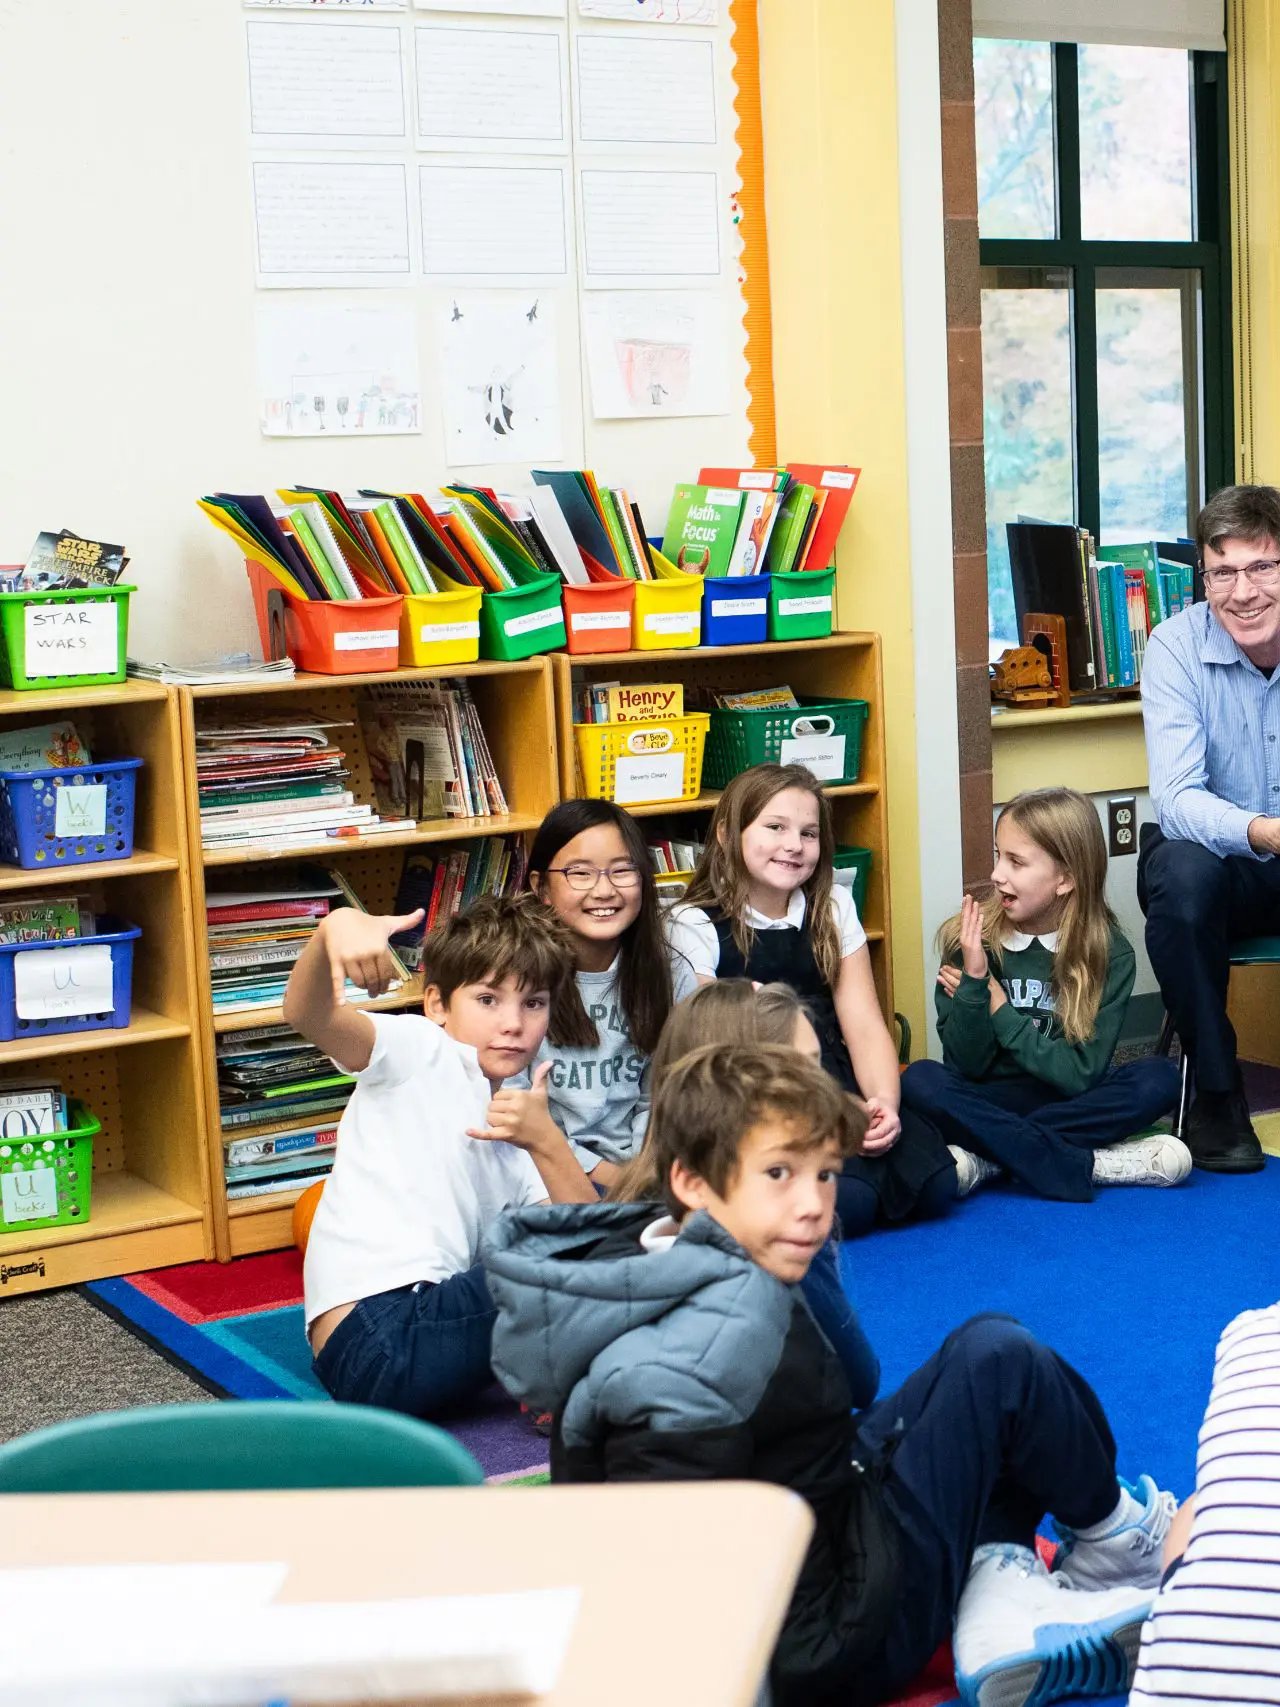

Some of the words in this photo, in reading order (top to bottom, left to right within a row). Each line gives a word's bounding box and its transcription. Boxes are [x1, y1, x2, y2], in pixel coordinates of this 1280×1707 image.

[686, 504, 716, 522] Math
[682, 521, 718, 542] Focus
[56, 544, 102, 561] WARS
[61, 537, 101, 552] STAR
[65, 559, 109, 577] EMPIRE
[33, 612, 92, 626] STAR
[37, 637, 88, 650] WARS
[618, 690, 676, 710] Henry
[639, 706, 654, 714] and
[66, 791, 92, 815] W
[260, 948, 298, 960] HISTORY
[53, 965, 81, 990] U
[550, 1054, 645, 1090] GATORS
[16, 1094, 50, 1105] DAHL
[0, 1107, 50, 1138] OY
[14, 1174, 38, 1197] U
